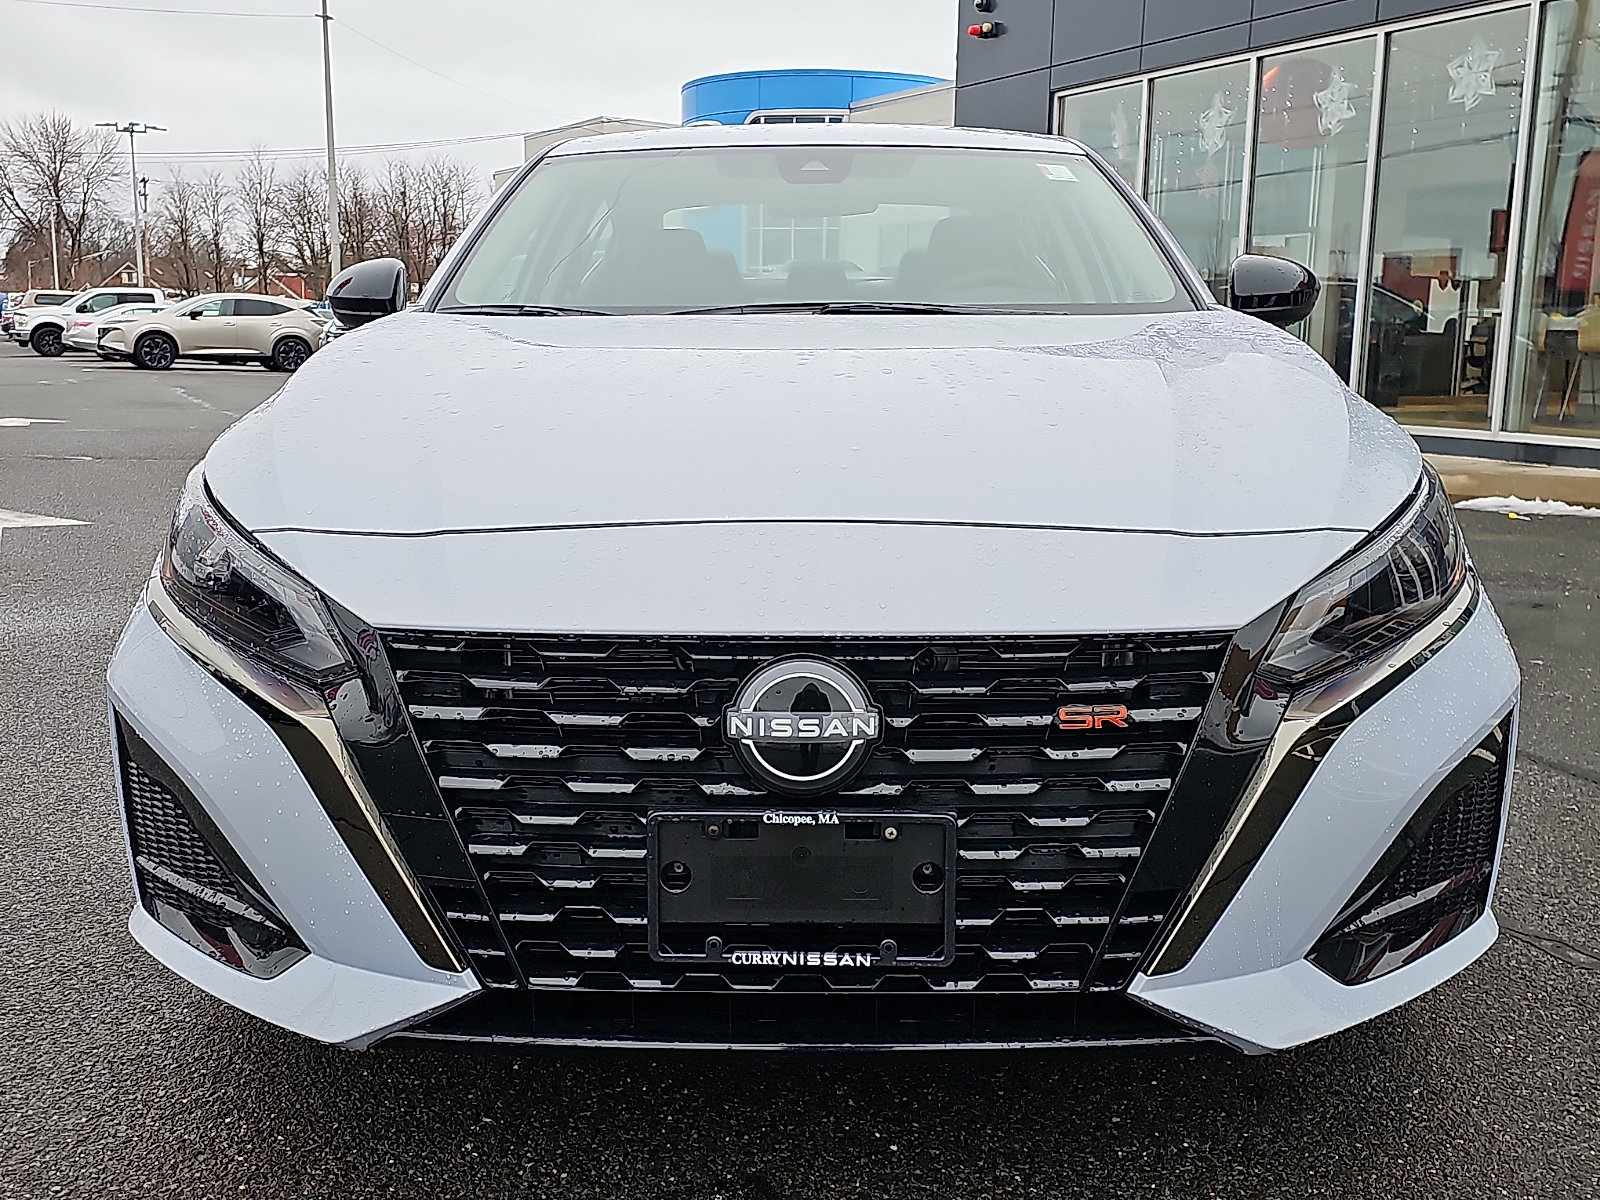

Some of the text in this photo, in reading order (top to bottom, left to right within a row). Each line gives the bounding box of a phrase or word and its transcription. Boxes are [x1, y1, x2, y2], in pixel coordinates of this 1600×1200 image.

[730, 716, 876, 737] NISSAN
[1058, 704, 1129, 730] SR
[762, 812, 840, 827] Chicopee, MA
